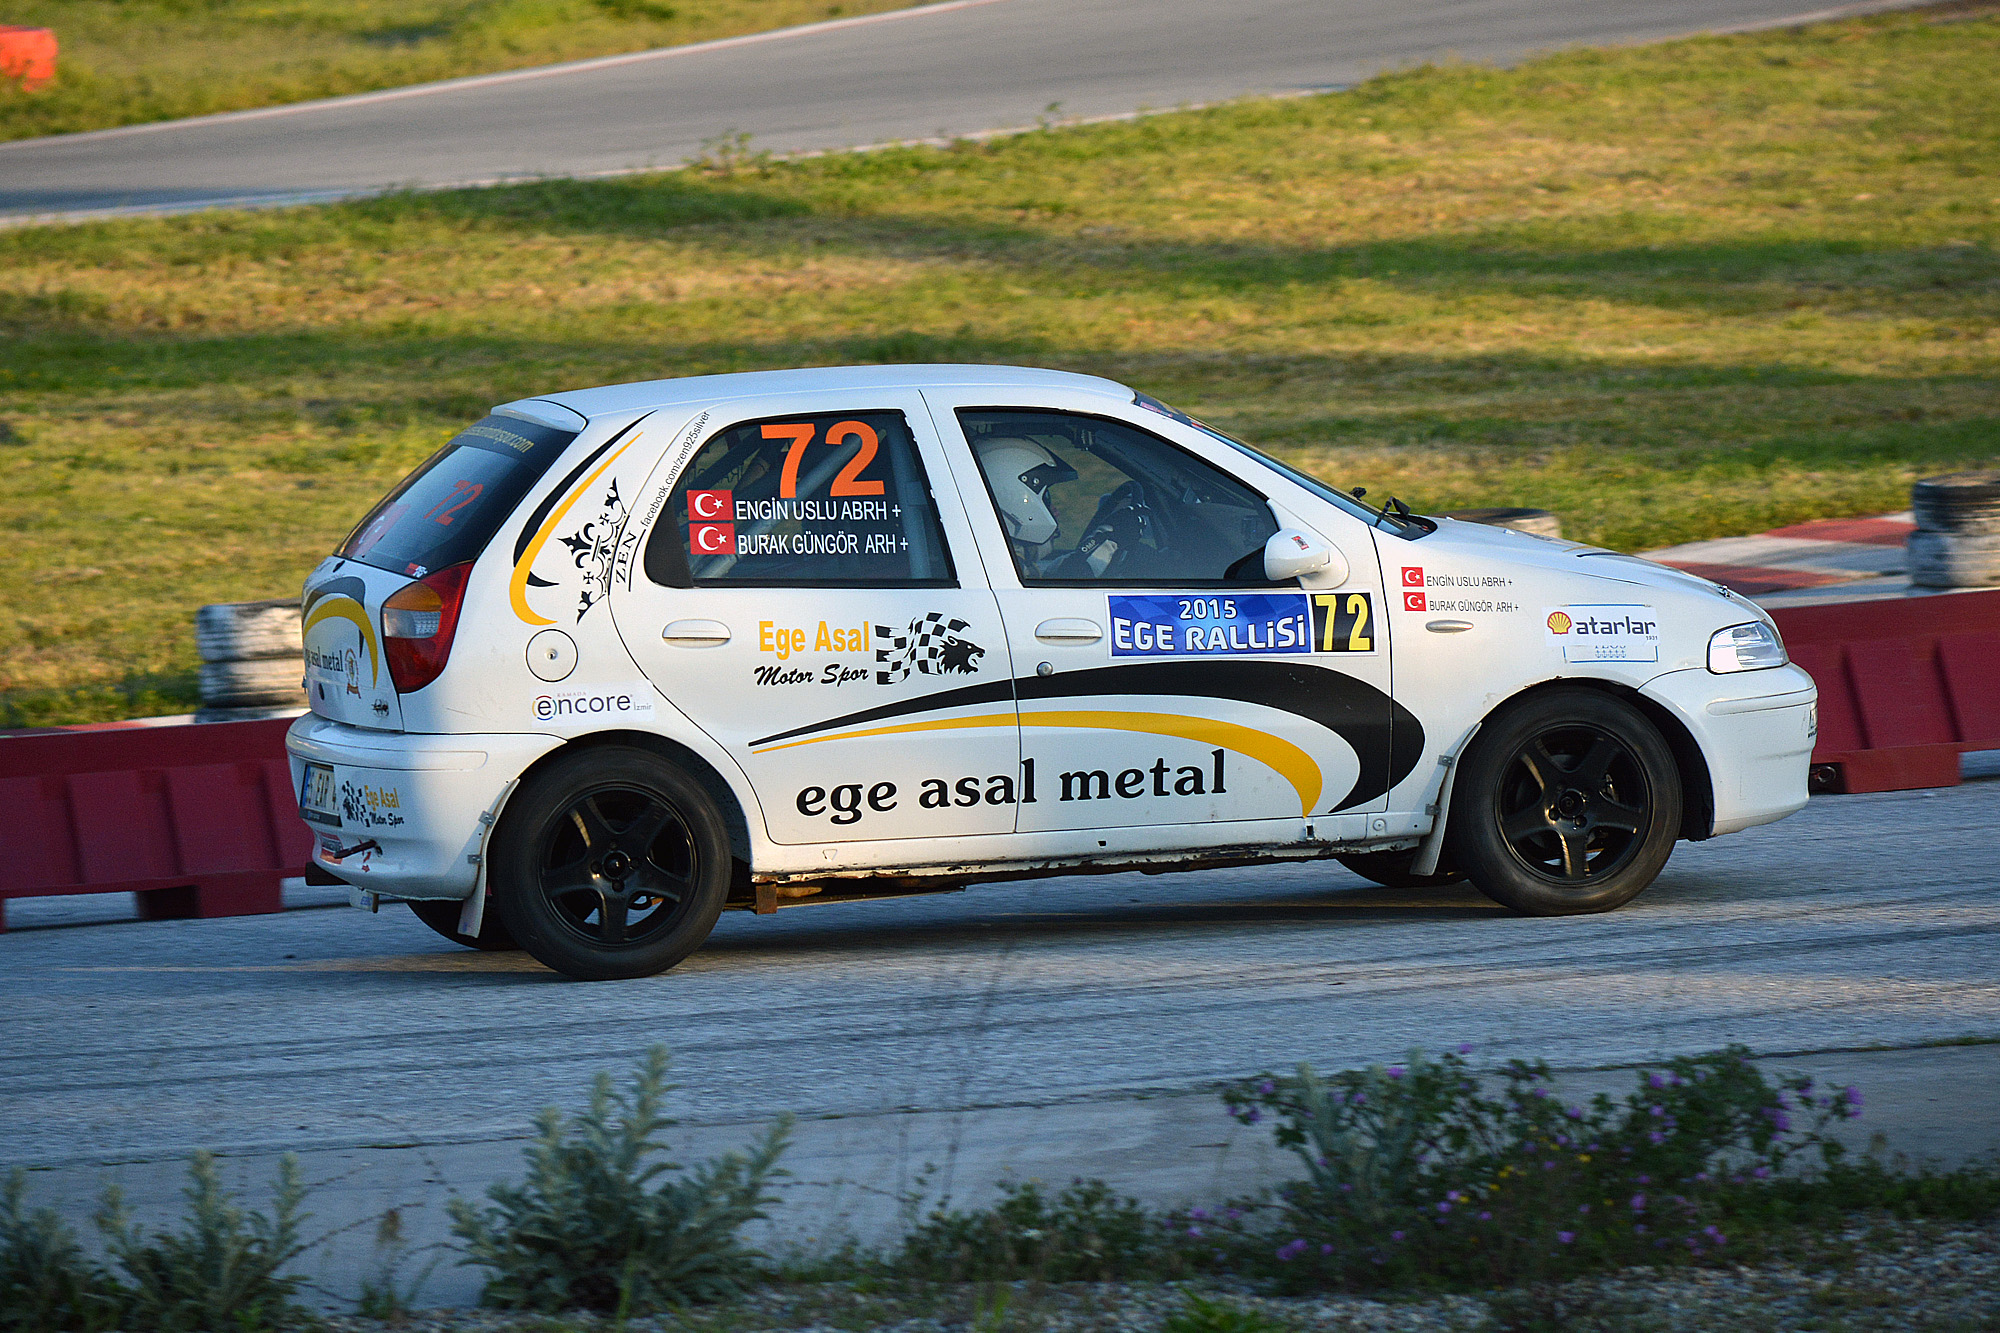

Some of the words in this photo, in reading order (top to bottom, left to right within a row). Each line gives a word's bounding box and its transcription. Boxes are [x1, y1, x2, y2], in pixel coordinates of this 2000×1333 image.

[640, 411, 711, 527] facebook.com/zen925silver
[760, 420, 885, 498] 72
[423, 480, 484, 526] 72
[735, 497, 788, 520] ENGİN
[793, 500, 837, 520] USLU
[840, 500, 887, 520] ABRH
[738, 534, 789, 555] BURAK
[792, 530, 859, 554] GÜNGÖR
[865, 534, 896, 554] ARH
[1081, 539, 1096, 553] OMP
[615, 530, 637, 583] ZEN
[1426, 574, 1455, 587] ENGİN
[1456, 576, 1480, 587] USLU
[1481, 576, 1506, 588] ABRH
[1178, 598, 1237, 620] 2015
[1429, 600, 1457, 612] BURAK
[1458, 599, 1493, 612] GÜNGÖR
[1496, 601, 1513, 612] ARH
[1113, 617, 1175, 651] EGE
[1314, 593, 1371, 651] 72
[1575, 615, 1656, 635] atarlar
[759, 620, 806, 660] Ege
[814, 620, 870, 652] Asal
[322, 649, 343, 672] metal
[753, 665, 814, 687] Motor
[820, 663, 869, 687] Spor
[537, 695, 631, 716] encore
[364, 784, 379, 811] Ege
[380, 786, 400, 808] Asal
[796, 780, 898, 825] ege
[918, 757, 1038, 809] asal
[1059, 749, 1228, 802] metal
